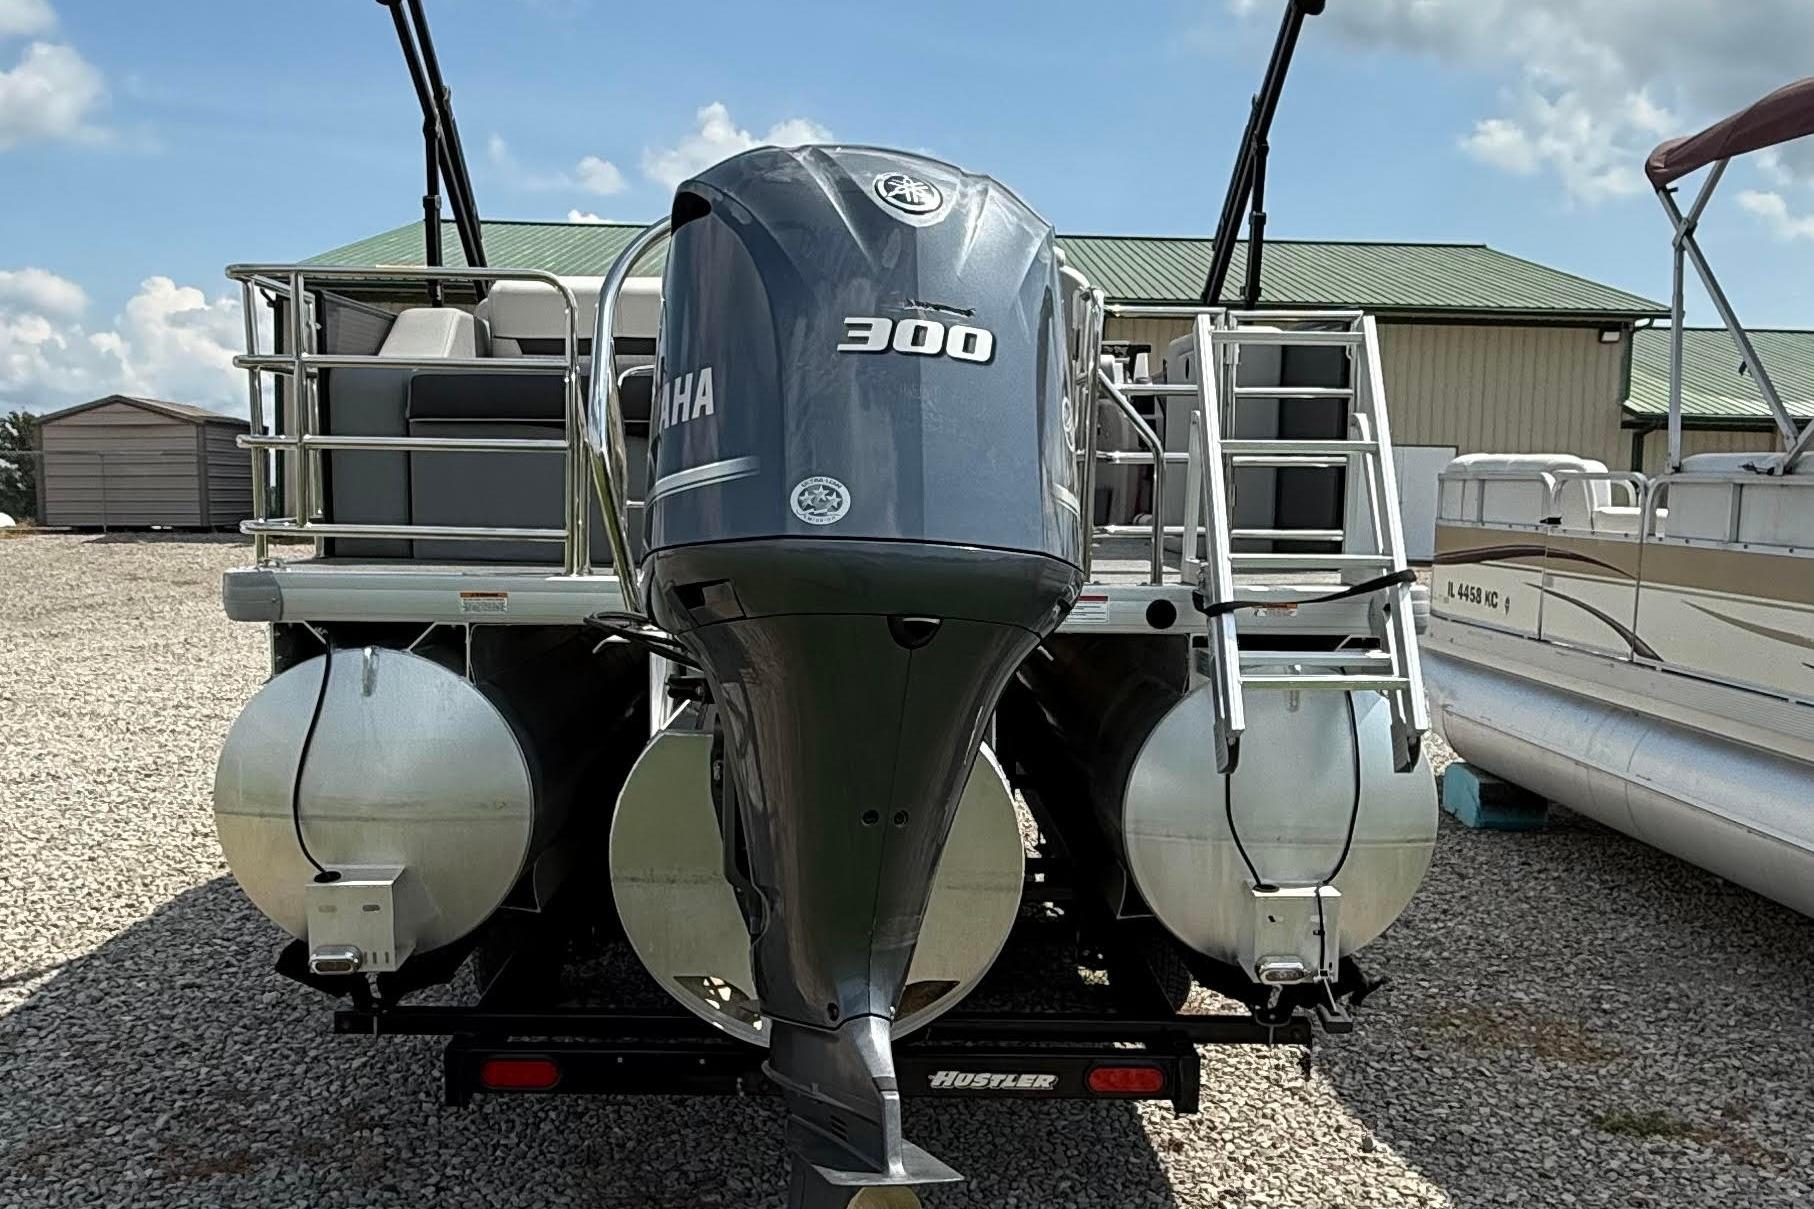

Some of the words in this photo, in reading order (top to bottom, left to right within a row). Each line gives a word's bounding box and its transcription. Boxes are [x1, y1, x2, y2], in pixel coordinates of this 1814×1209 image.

[837, 317, 994, 362] 300
[1448, 581, 1455, 598] IL
[1458, 584, 1482, 604] 4458
[1485, 590, 1498, 608] KC
[928, 1071, 1058, 1090] HUSTLER
